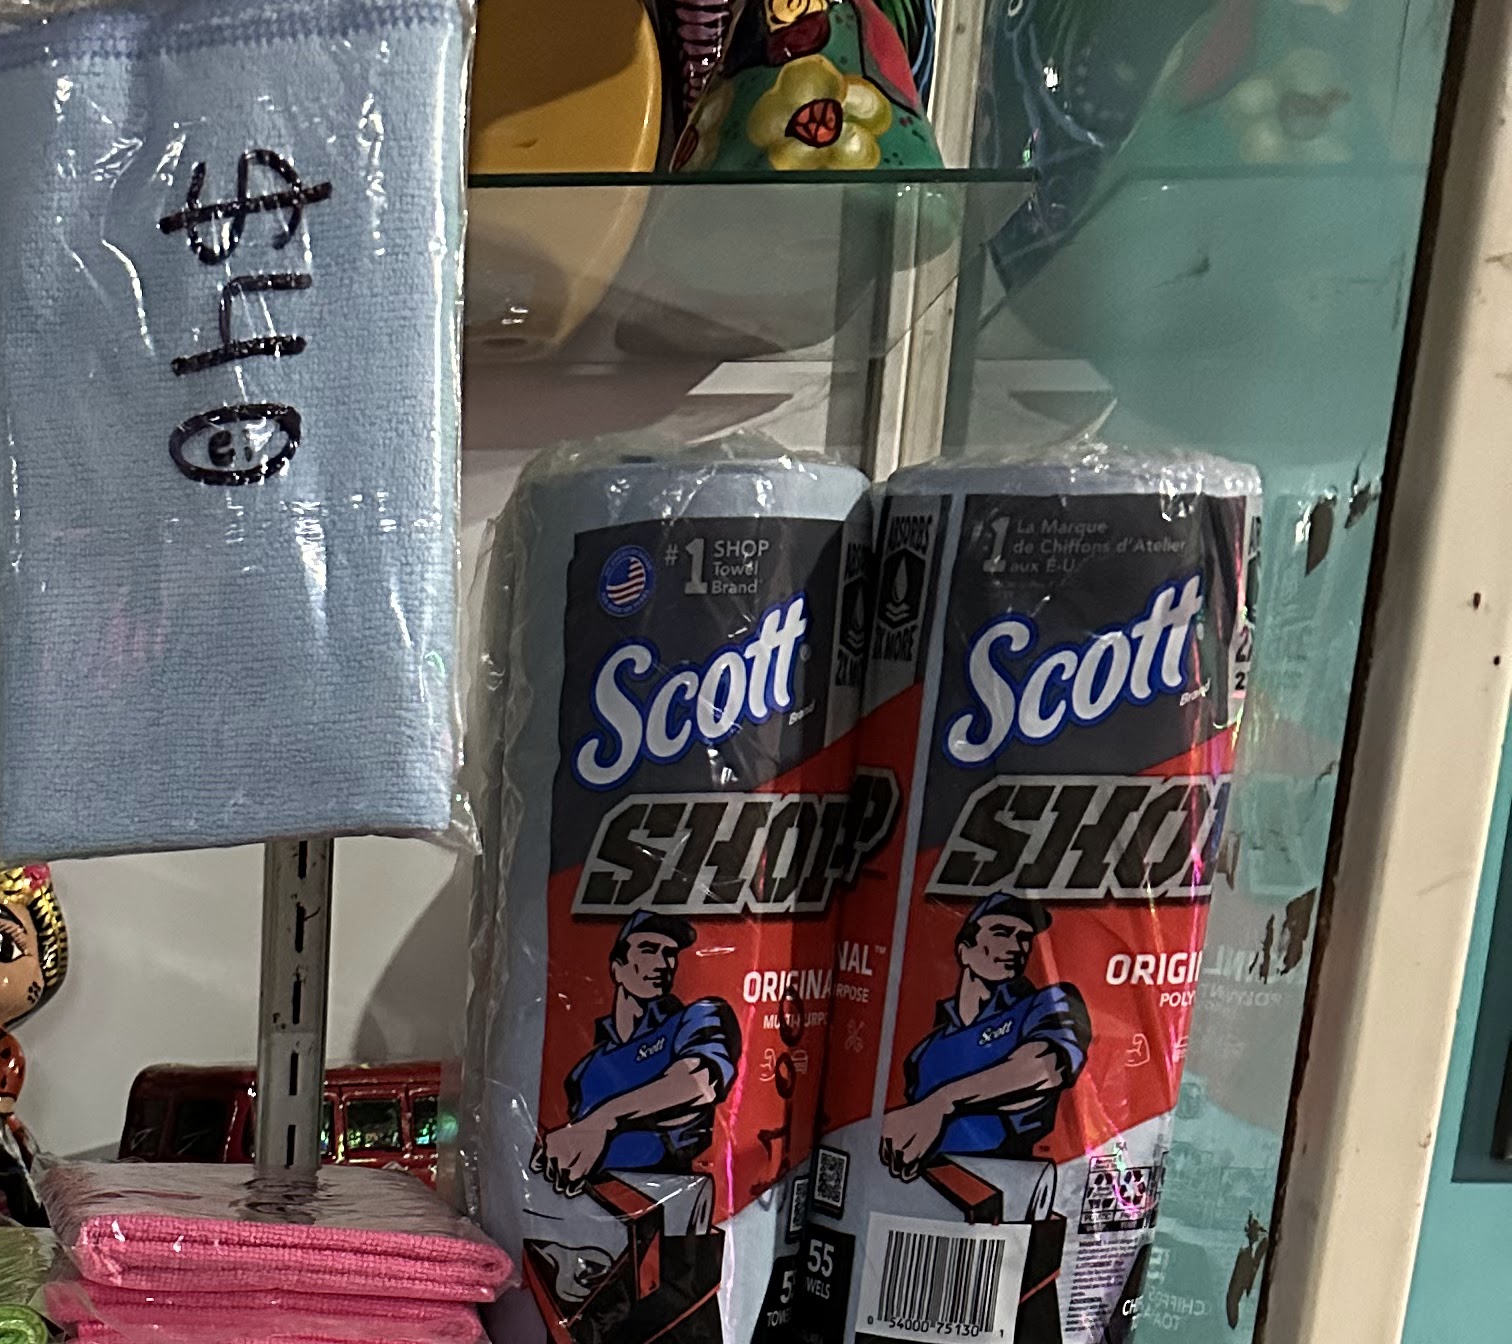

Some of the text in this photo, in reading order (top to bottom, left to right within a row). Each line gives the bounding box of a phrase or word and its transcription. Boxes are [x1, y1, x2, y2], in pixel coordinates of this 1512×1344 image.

[1017, 519, 1108, 540] La Marque
[713, 540, 769, 557] SHOP
[1013, 540, 1034, 554] de
[713, 561, 758, 576] Towel
[711, 579, 758, 594] Brand
[945, 576, 1204, 764] Scott
[574, 594, 807, 788] Scott
[924, 775, 1233, 901] SHO
[1105, 952, 1201, 985] ORIGI
[743, 968, 832, 1004] ORIGINA
[806, 1239, 835, 1278] 55
